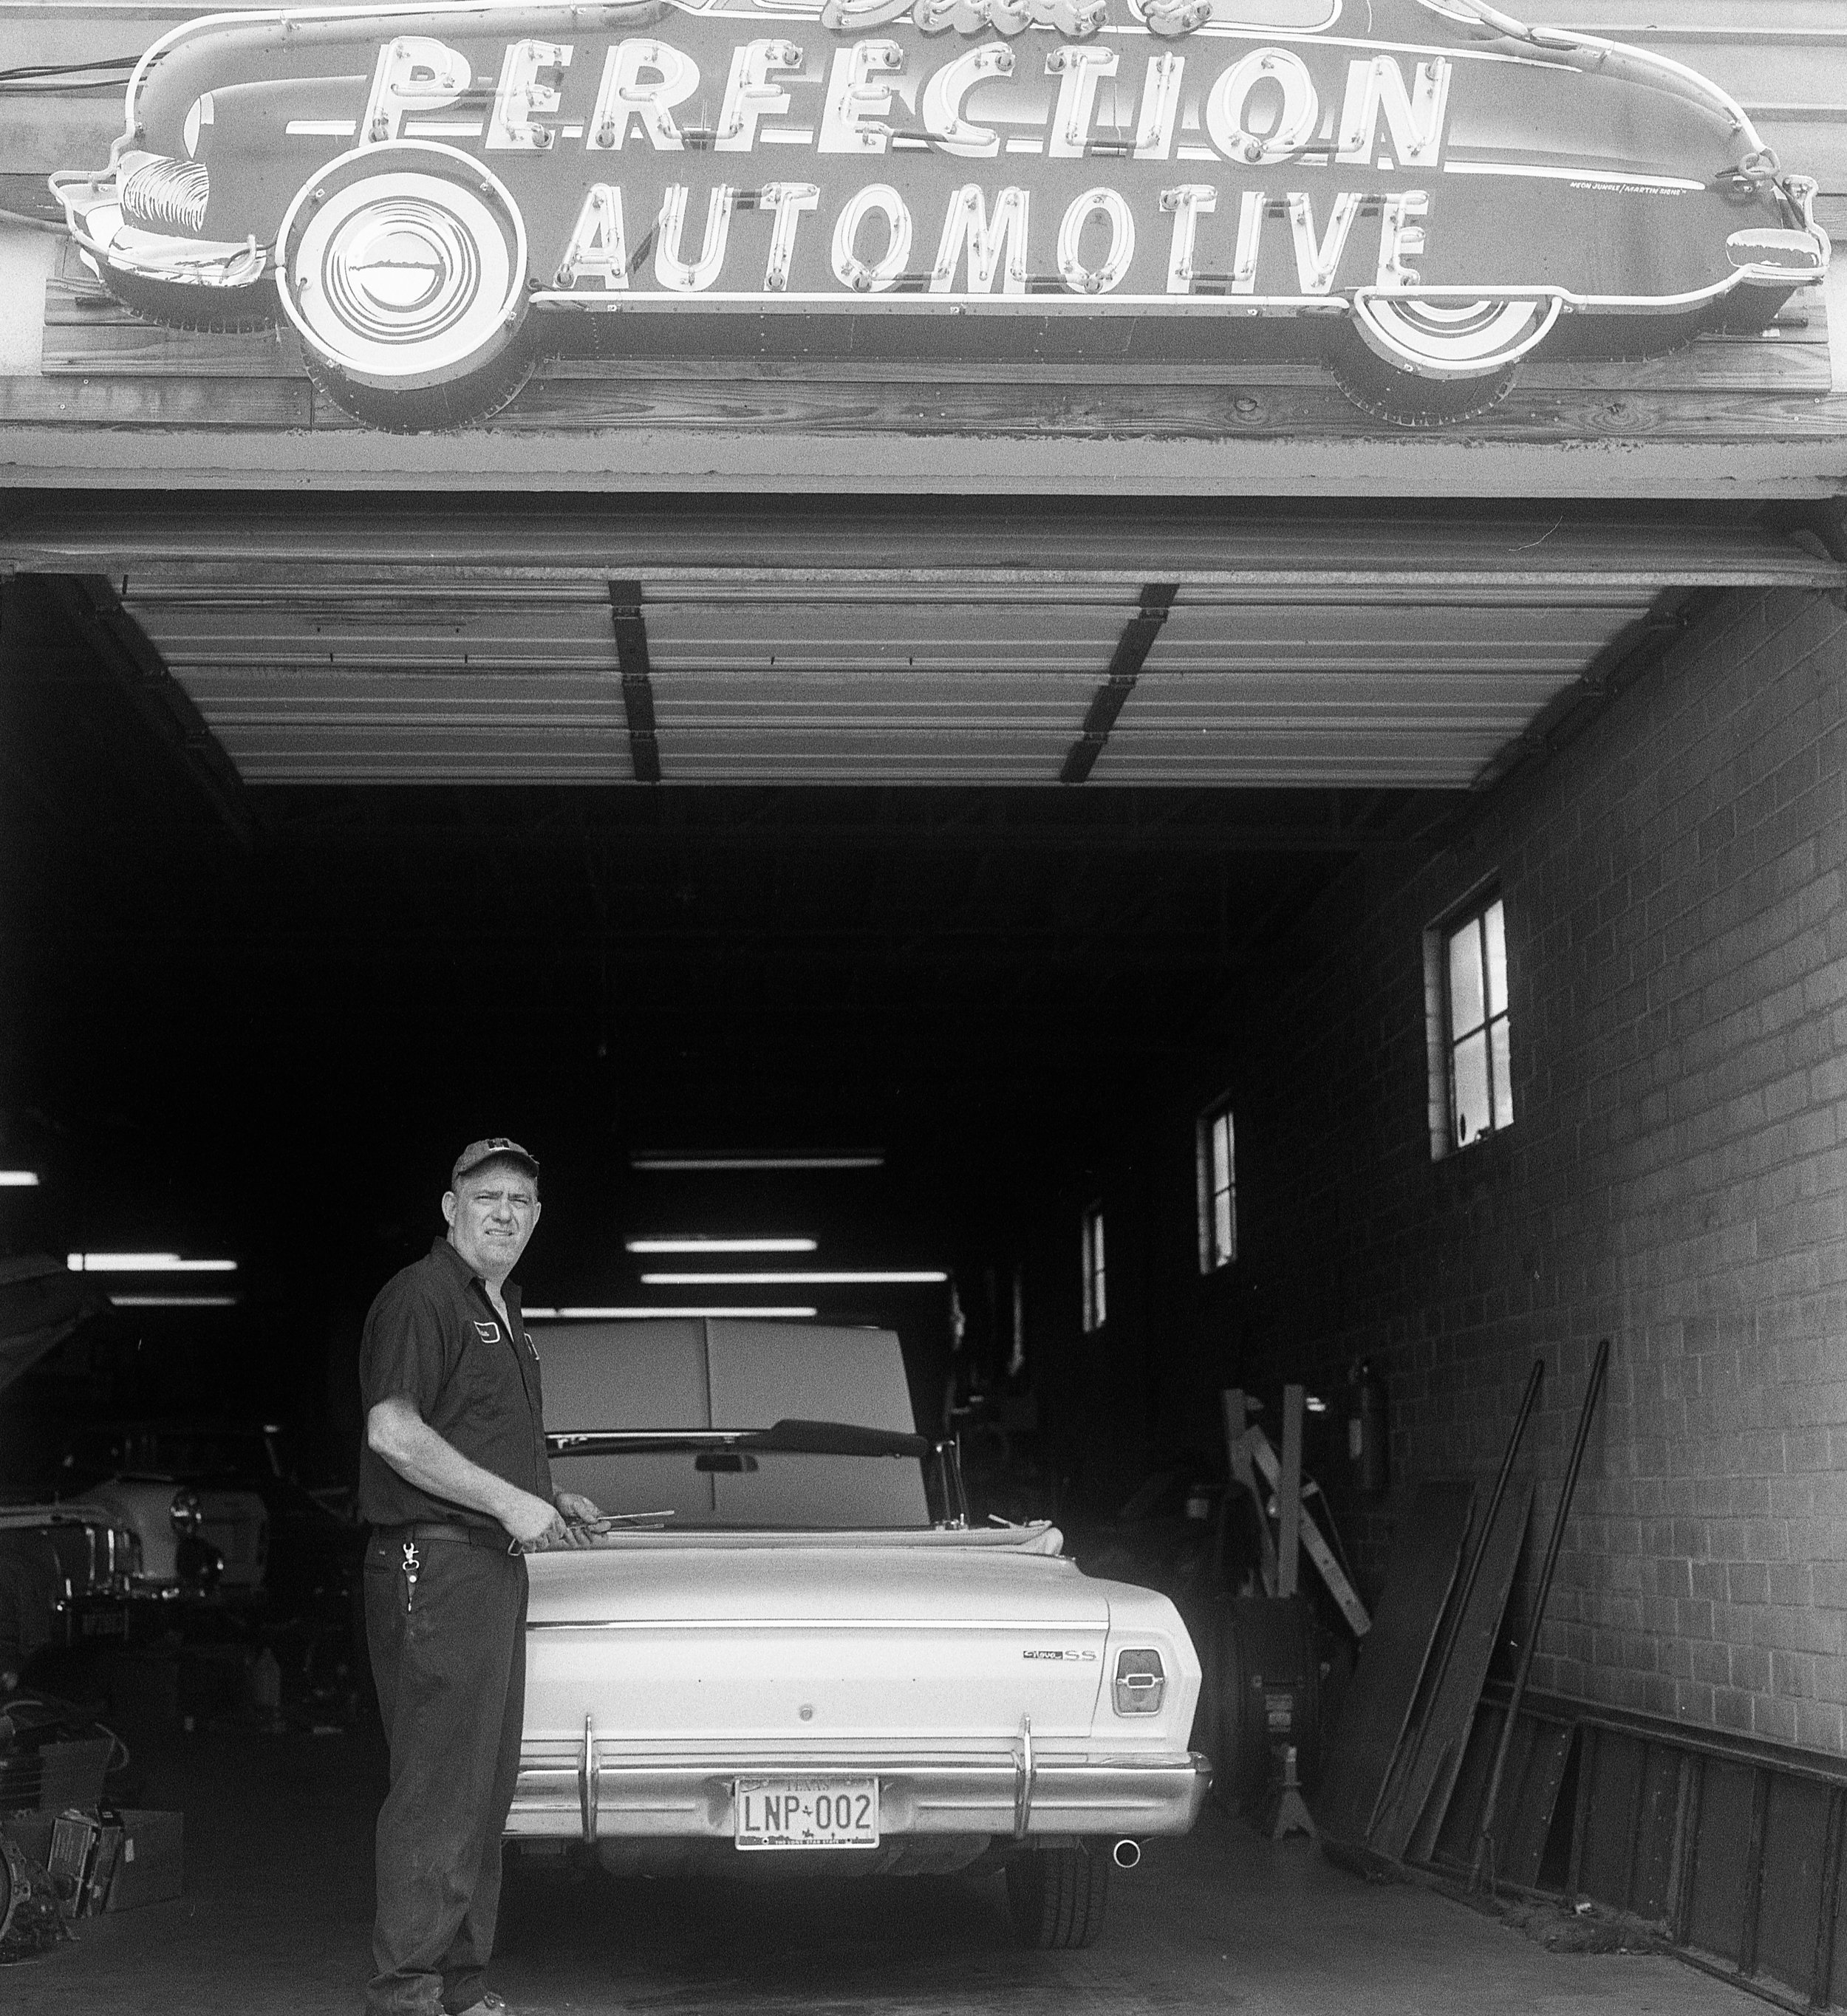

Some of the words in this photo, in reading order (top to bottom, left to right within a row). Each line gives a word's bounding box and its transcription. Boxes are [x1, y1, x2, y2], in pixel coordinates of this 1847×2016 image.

[359, 35, 1452, 167] PERFECTION
[552, 182, 1430, 295] AUTOMOTIVE
[1065, 1650, 1096, 1661] SS
[787, 1780, 829, 1791] TEXAS
